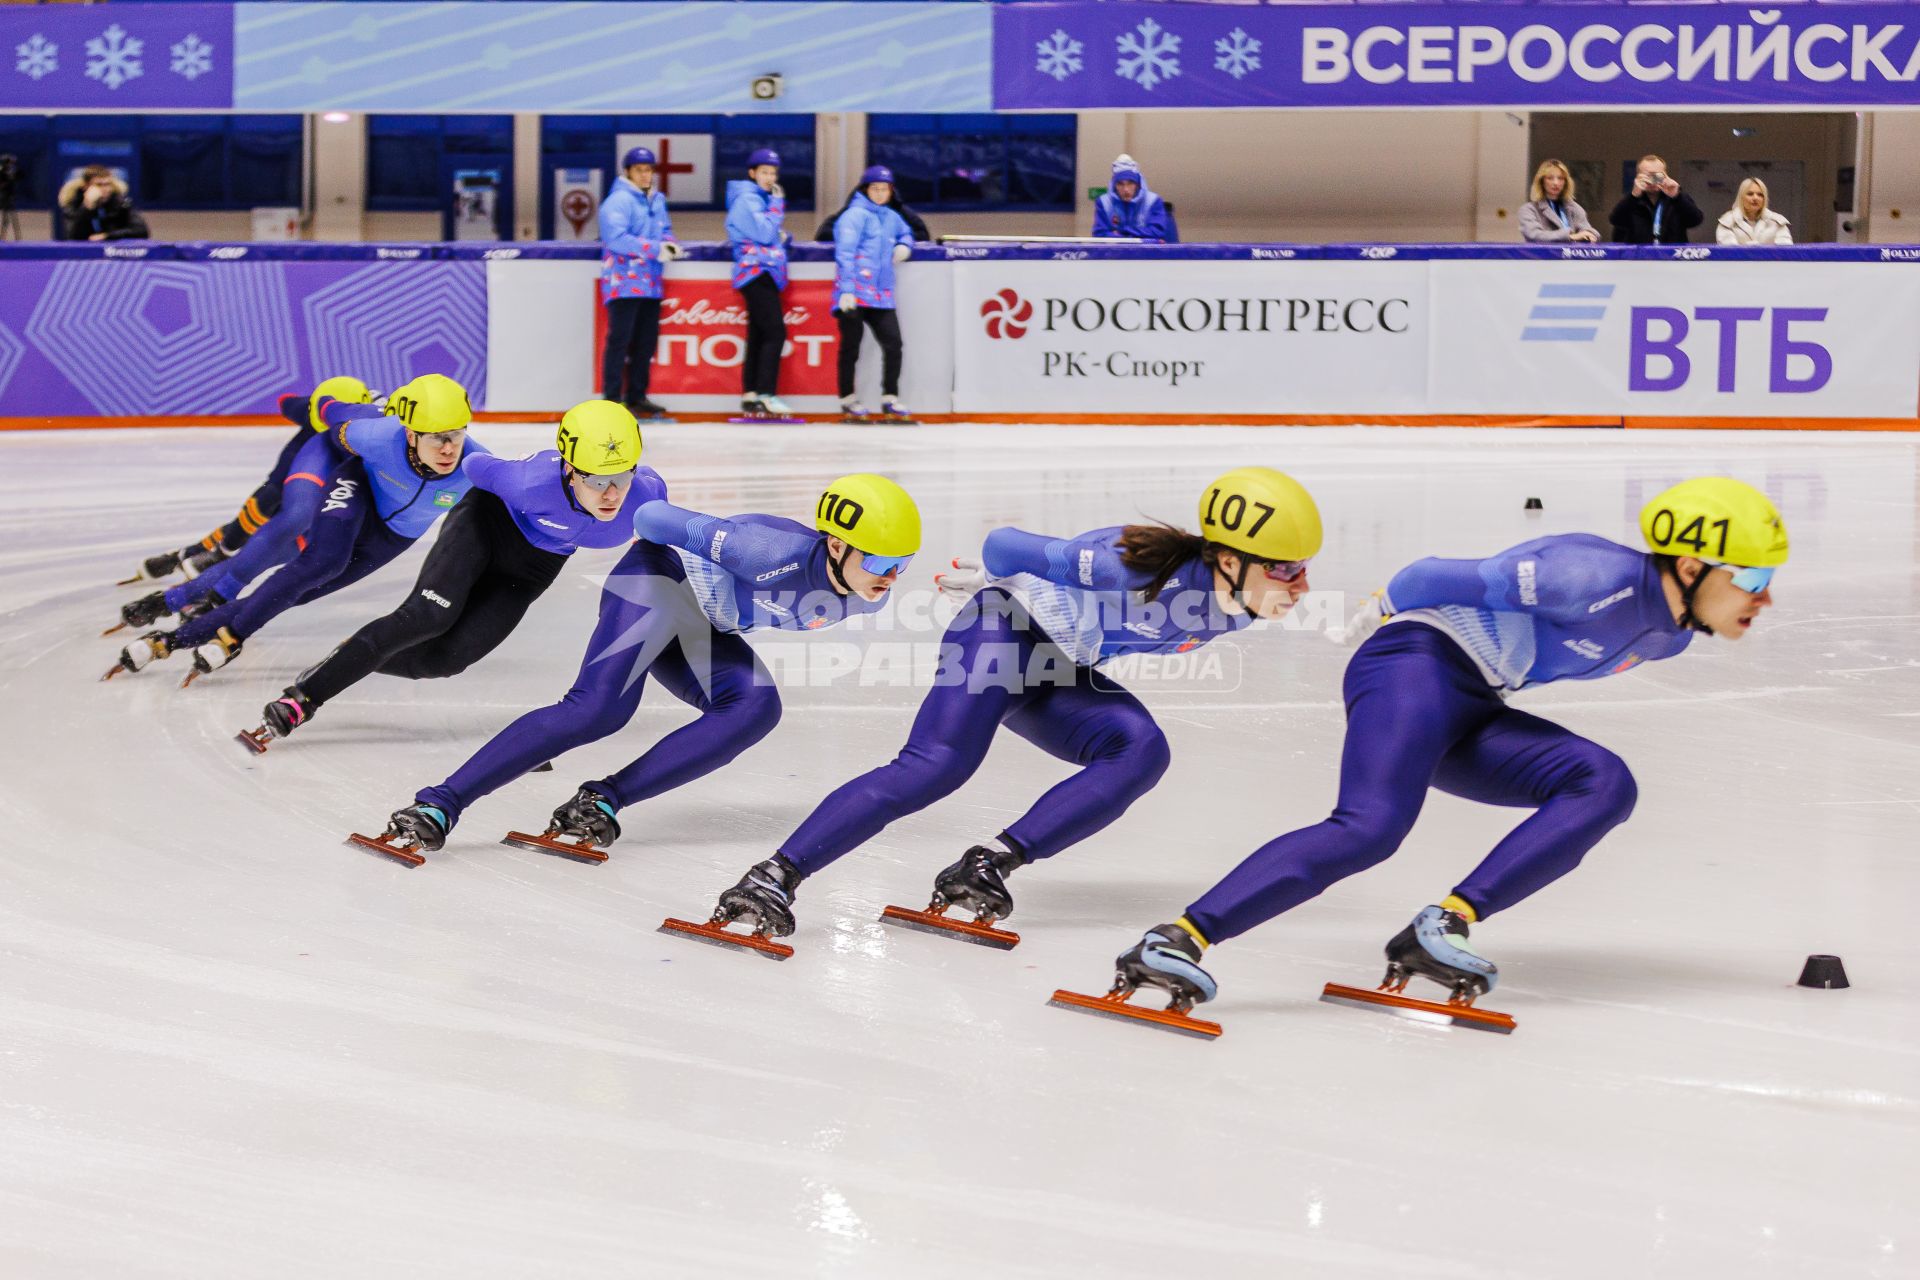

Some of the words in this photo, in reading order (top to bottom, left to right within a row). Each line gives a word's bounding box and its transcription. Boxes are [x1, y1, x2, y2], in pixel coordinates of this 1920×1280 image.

[1041, 297, 1410, 332] РОСКОНГРЕСС
[1041, 351, 1205, 387] РК-Спорт
[1628, 306, 1833, 393] ВТБ
[320, 477, 359, 513] УФА
[817, 491, 864, 531] 110
[1204, 488, 1276, 538] 107
[1652, 509, 1730, 557] 041
